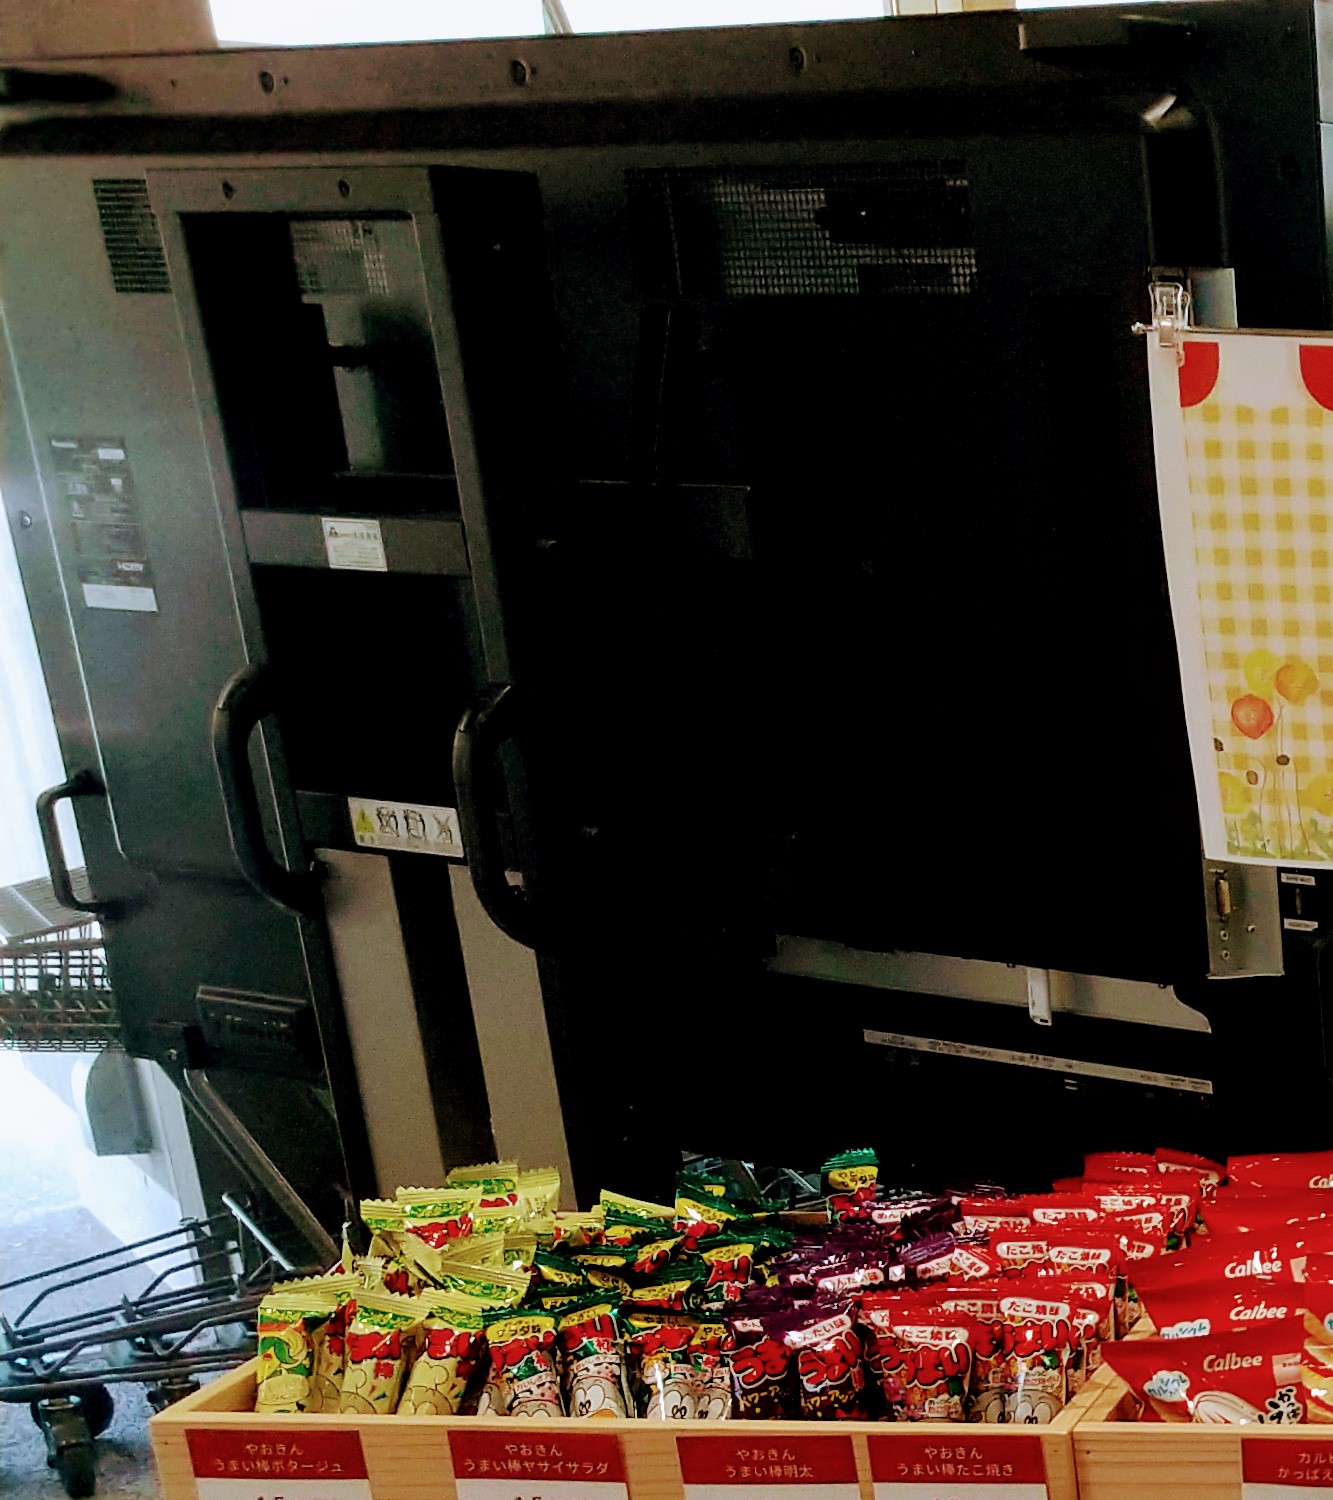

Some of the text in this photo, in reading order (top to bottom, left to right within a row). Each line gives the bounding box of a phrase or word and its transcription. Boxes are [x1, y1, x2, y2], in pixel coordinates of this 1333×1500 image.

[1224, 1257, 1283, 1279] Calbee
[1229, 1300, 1288, 1321] Calbee
[1203, 1352, 1263, 1373] Calbee
[244, 1443, 304, 1457] やおきん
[504, 1443, 563, 1458] やおきん
[736, 1447, 796, 1461] やおきん
[924, 1445, 984, 1461] やおきん
[213, 1458, 345, 1474] うまい棒ポタージュ
[462, 1458, 609, 1476] うまい棒ヤサイサラダ
[725, 1463, 814, 1479] うまい棒明太
[897, 1462, 1015, 1478] うまい棒たこ焼き
